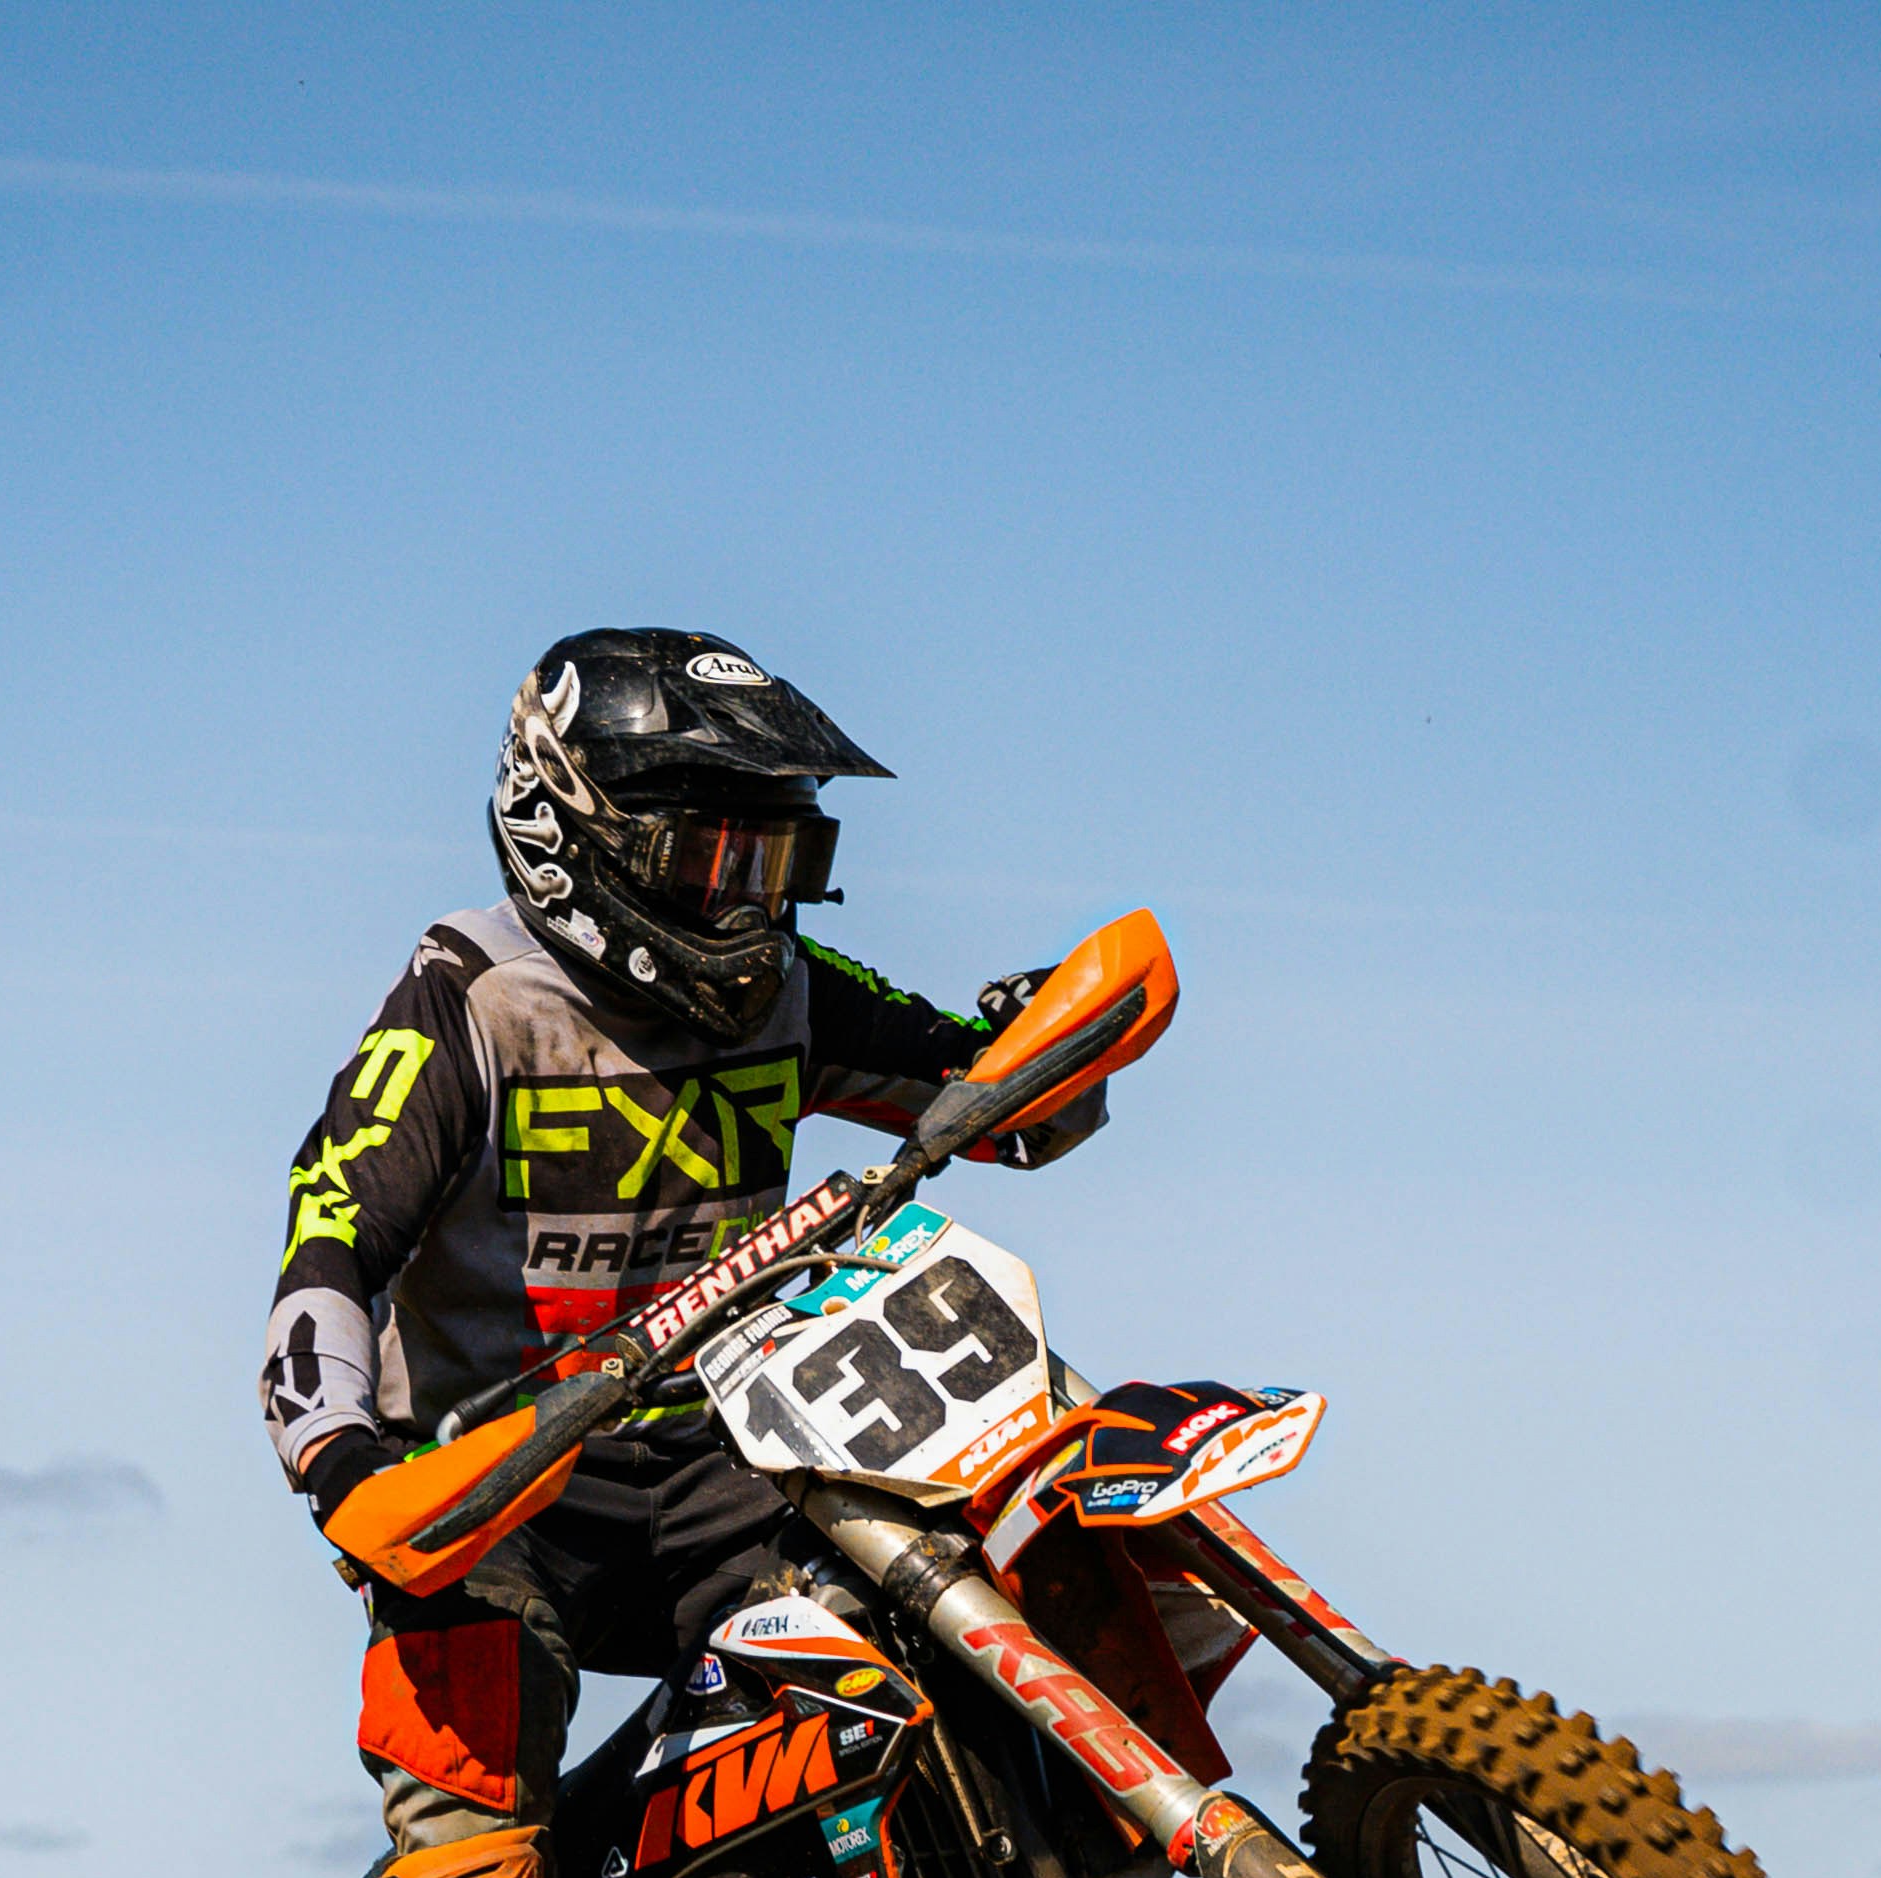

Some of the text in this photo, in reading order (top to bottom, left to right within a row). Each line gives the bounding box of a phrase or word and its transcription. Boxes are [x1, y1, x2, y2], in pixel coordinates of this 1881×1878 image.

[504, 1056, 801, 1200] FXR
[644, 1186, 853, 1352] RENTHAL
[844, 1222, 934, 1292] MOOREX
[745, 1254, 1039, 1474] 139
[958, 1408, 1038, 1478] KTM
[1169, 1401, 1240, 1450] NGK
[1091, 1479, 1159, 1499] GoPro
[634, 1710, 839, 1871] KTM
[828, 1827, 871, 1858] MOTOREX
